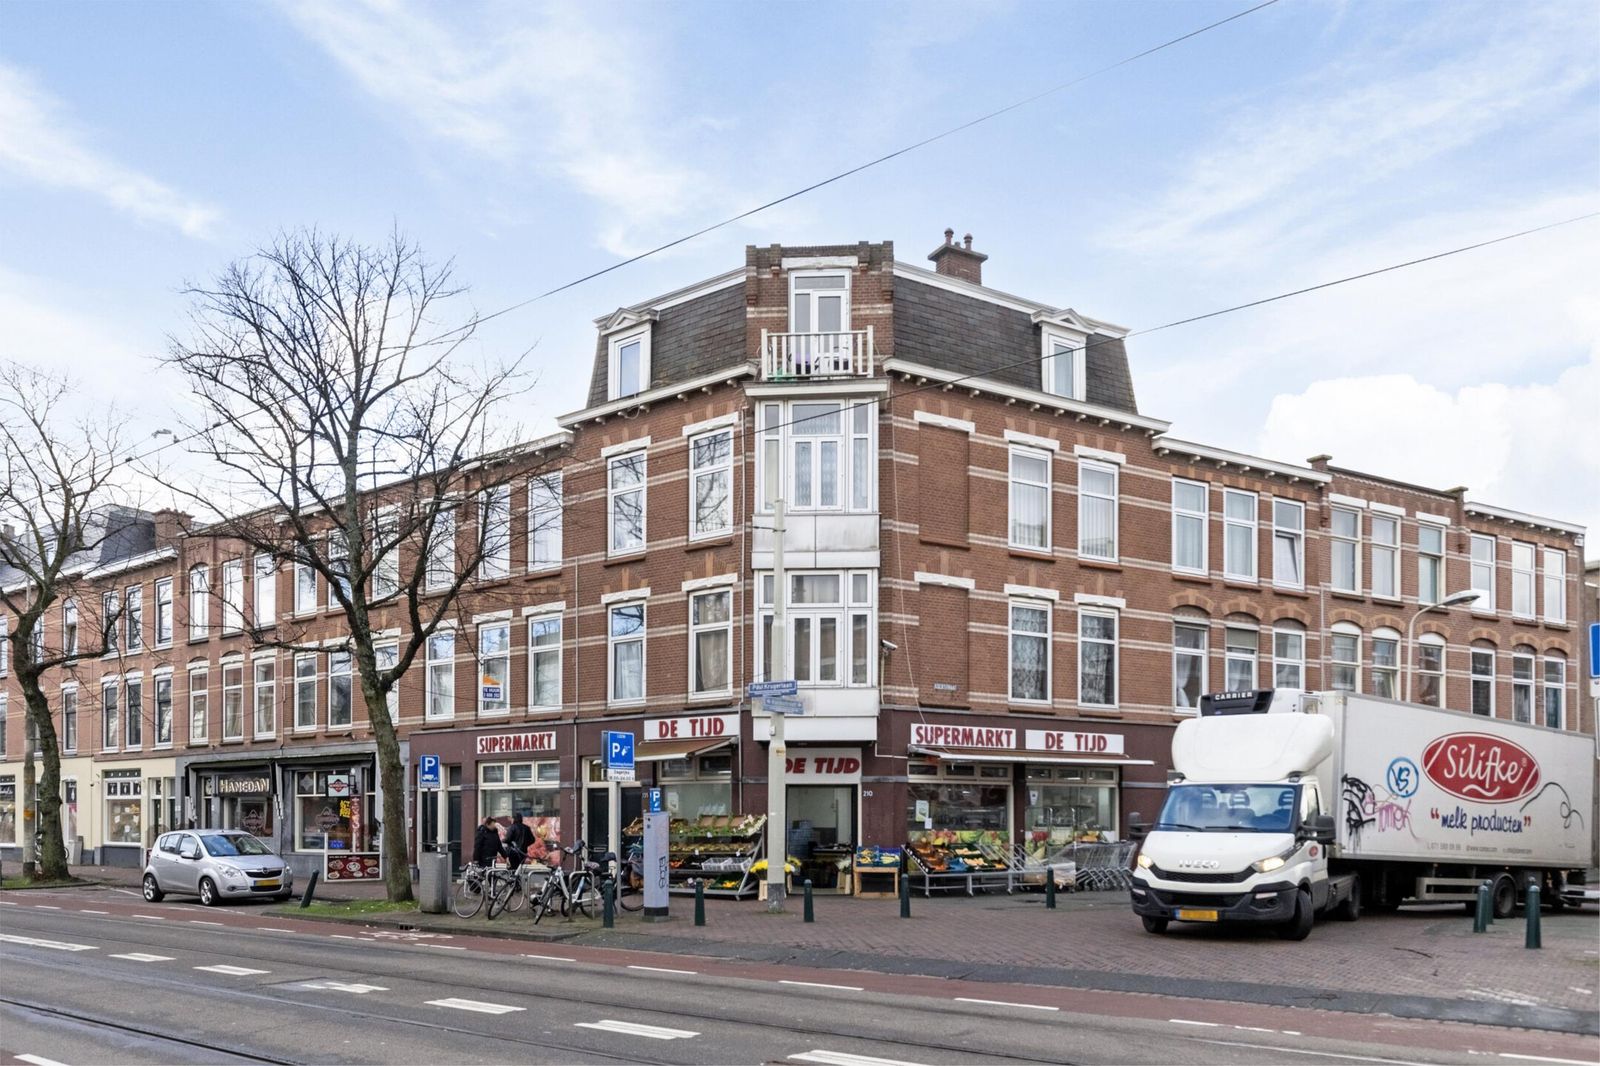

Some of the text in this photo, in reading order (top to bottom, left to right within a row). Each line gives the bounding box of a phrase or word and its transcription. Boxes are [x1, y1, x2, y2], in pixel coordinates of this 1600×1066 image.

[1215, 692, 1252, 700] CARRIER
[659, 717, 724, 738] DE TIJD
[915, 726, 1013, 748] SUPERMARKT
[479, 733, 553, 753] SUPERMARKT
[1045, 732, 1107, 751] DE TIJD
[814, 757, 861, 774] TIJD
[1444, 743, 1523, 789] Silifke
[1179, 859, 1219, 869] IVECO
